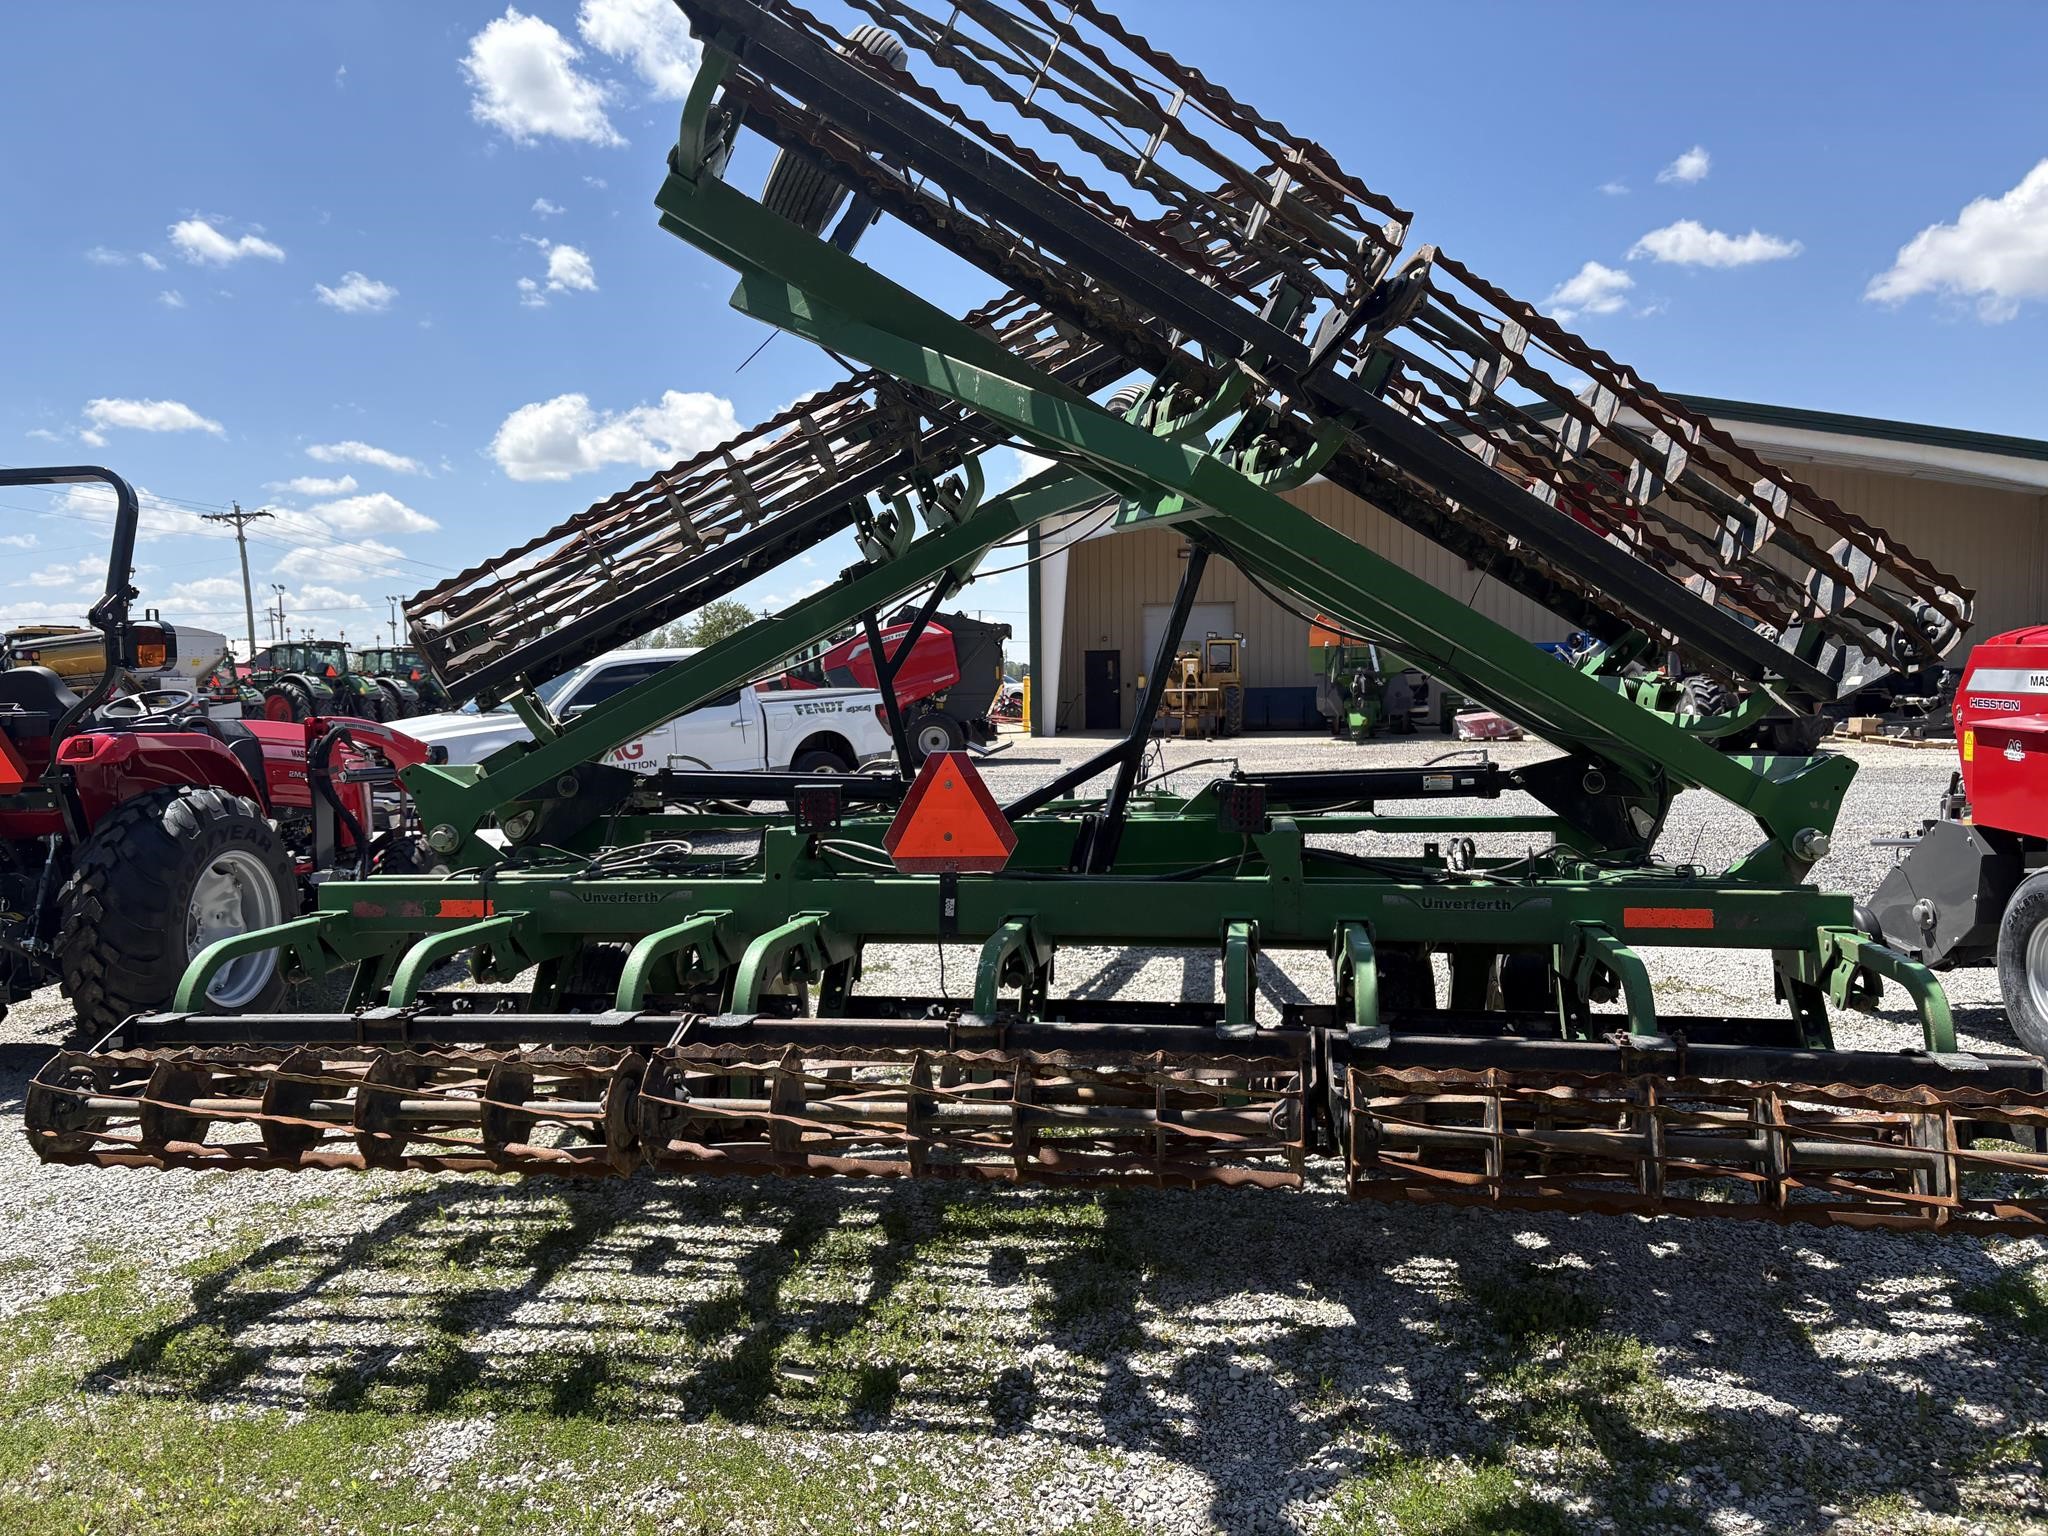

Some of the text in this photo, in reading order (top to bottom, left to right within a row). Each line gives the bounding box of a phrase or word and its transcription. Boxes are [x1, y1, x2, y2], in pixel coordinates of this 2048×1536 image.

[794, 701, 845, 716] FENDT
[1970, 698, 2020, 711] HESSTON
[2008, 739, 2022, 753] AG
[582, 891, 659, 903] Unverferth
[1422, 897, 1512, 911] Unverferth
